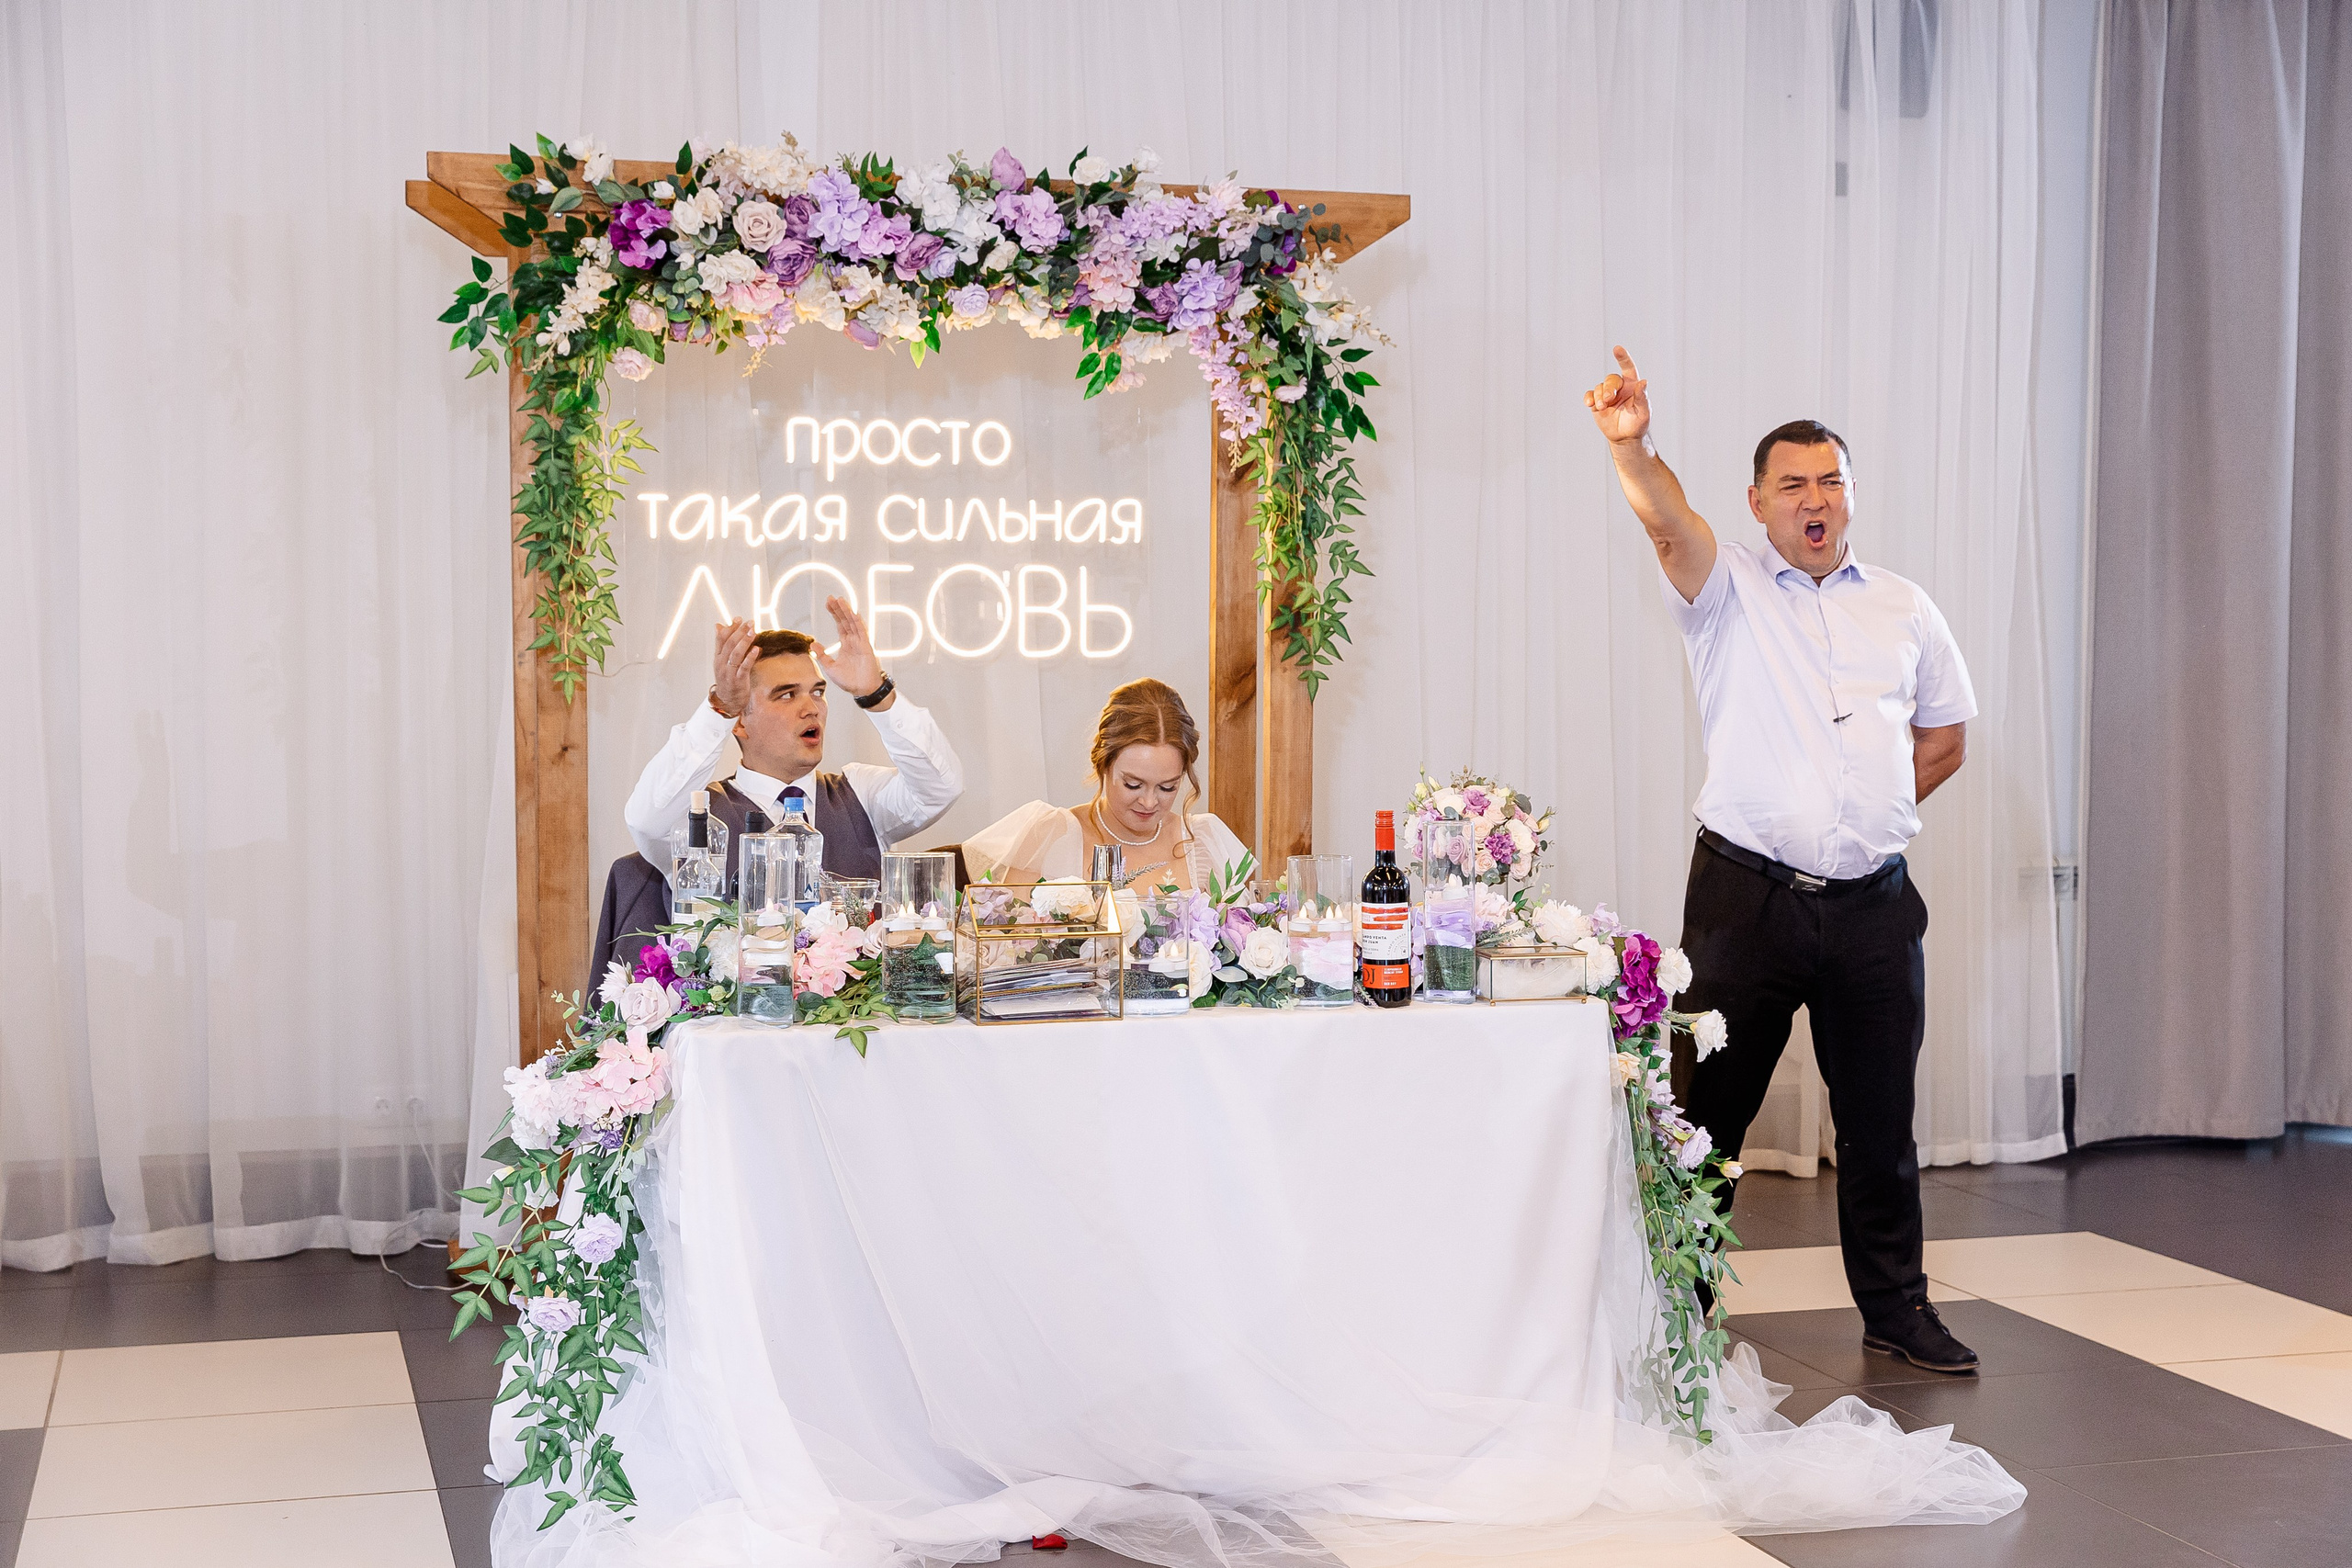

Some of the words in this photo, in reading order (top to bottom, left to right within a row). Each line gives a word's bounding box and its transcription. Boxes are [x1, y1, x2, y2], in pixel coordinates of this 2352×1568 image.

[786, 415, 1012, 482] просто
[636, 492, 848, 547] такая
[876, 494, 1144, 545] сильная
[656, 561, 1134, 660] ЛЮБОВЬ
